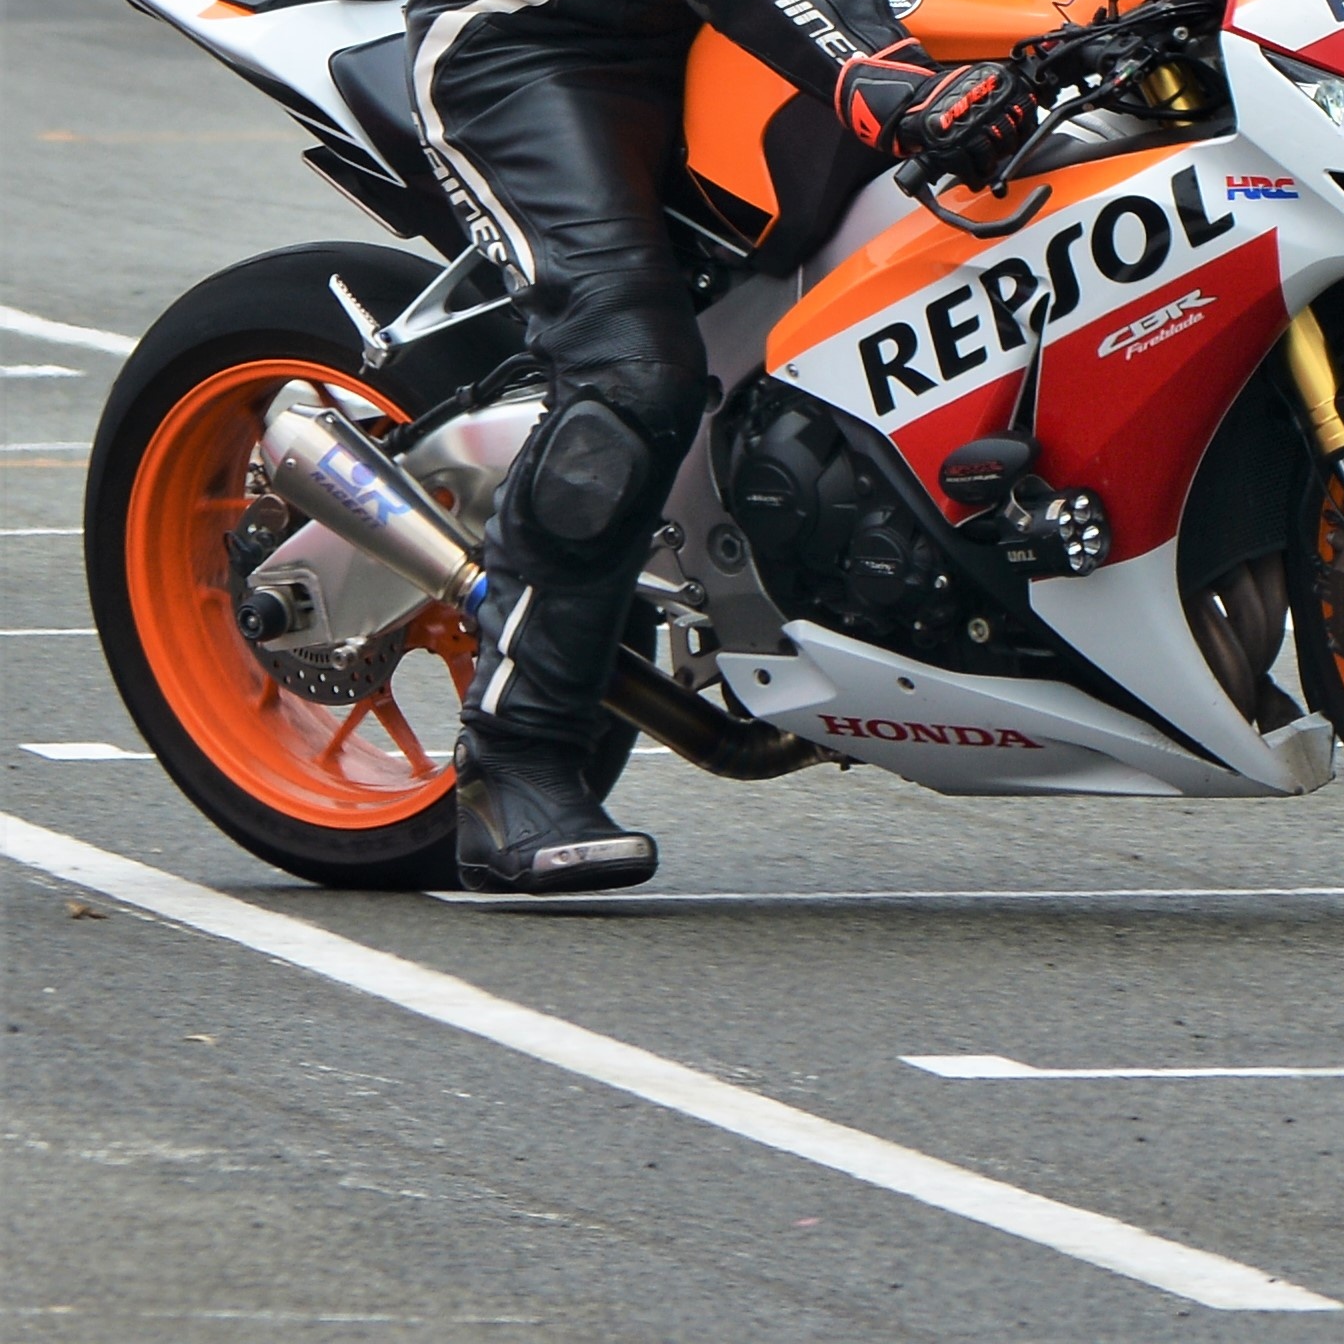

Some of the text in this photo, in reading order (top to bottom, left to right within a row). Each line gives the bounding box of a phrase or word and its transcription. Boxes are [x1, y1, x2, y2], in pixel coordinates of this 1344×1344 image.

[1225, 175, 1299, 201] HRC
[858, 164, 1237, 417] REPSOL
[1098, 288, 1218, 359] CBR
[1125, 311, 1206, 361] Fireblade
[817, 713, 1044, 749] HONDA
